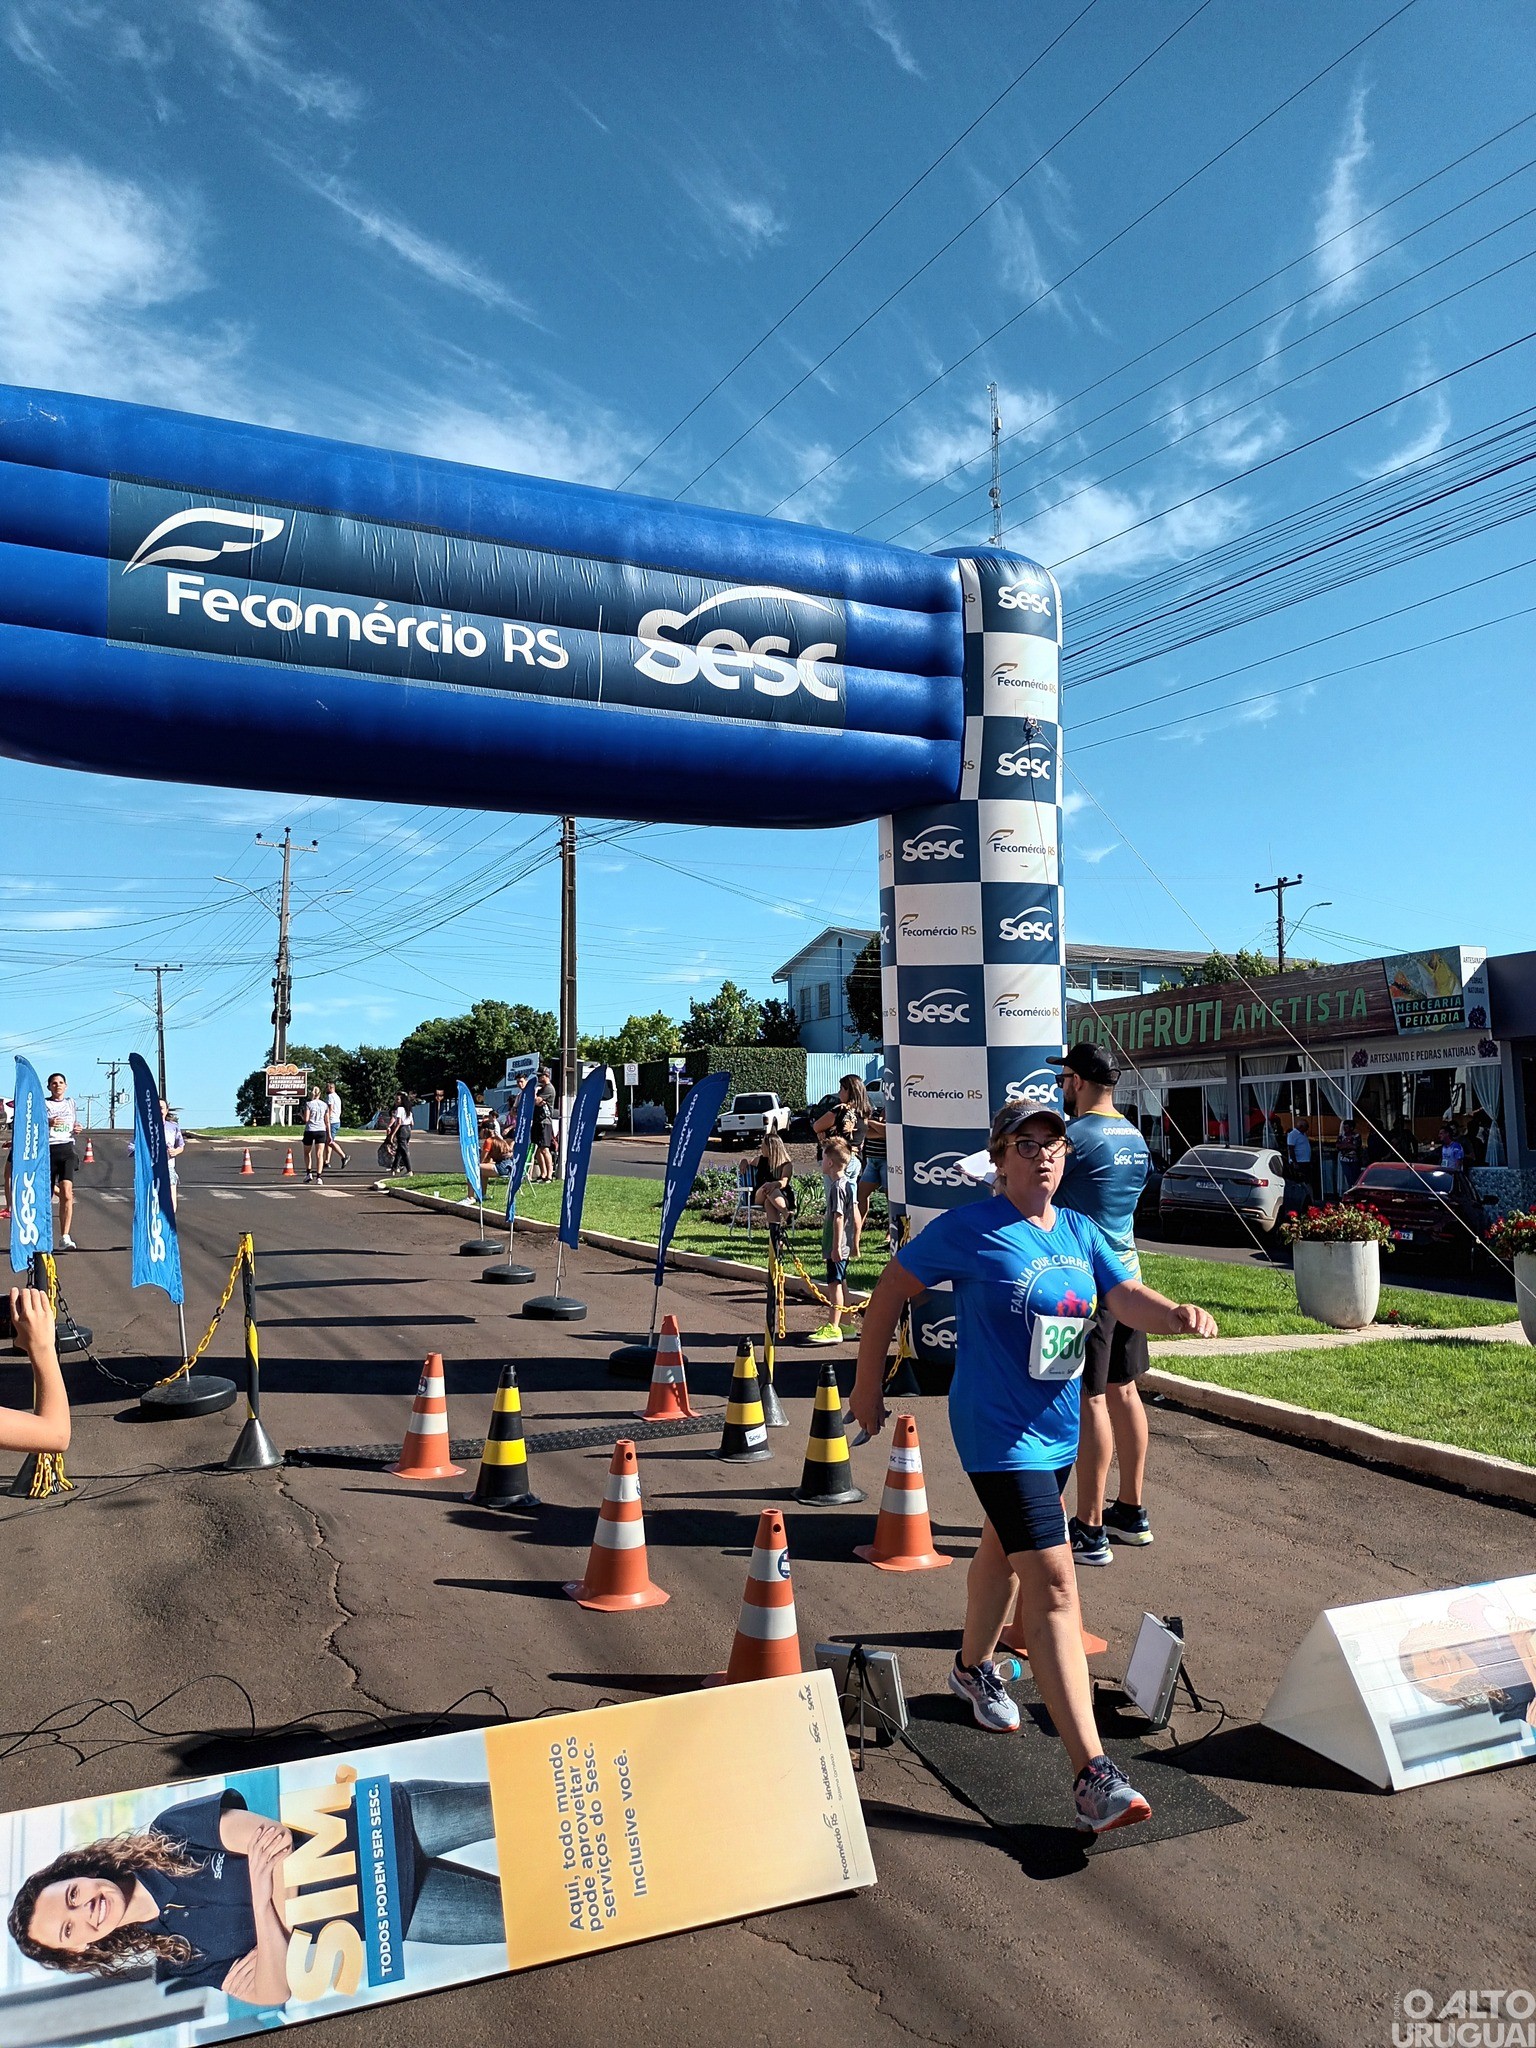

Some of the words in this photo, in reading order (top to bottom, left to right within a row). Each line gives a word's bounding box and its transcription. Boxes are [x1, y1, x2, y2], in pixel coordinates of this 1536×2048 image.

[997, 578, 1052, 617] Sesc
[166, 571, 487, 659] Fecomércio
[503, 622, 570, 671] RS
[634, 585, 840, 702] Sesc
[997, 676, 1048, 692] Fecomércio
[1049, 680, 1057, 694] RS
[996, 742, 1052, 780] Sesc
[902, 824, 965, 862] Sesc
[993, 842, 1046, 855] Fecomércio
[1047, 845, 1056, 856] RS
[902, 924, 958, 937] Fecomércio
[961, 925, 977, 936] RS
[998, 906, 1054, 941] Sesc
[907, 988, 970, 1023] Sesc
[999, 1006, 1051, 1018] Fecomércio
[1052, 1007, 1060, 1018] RS
[1067, 1000, 1222, 1051] HORTIFRUTI
[1232, 987, 1368, 1031] AMETISTA
[1396, 996, 1462, 1013] MERCEARIA
[1405, 1011, 1460, 1027] PEIXARIA
[1370, 1051, 1410, 1064] ARTESANATO
[1411, 1051, 1415, 1061] E
[1416, 1049, 1441, 1061] PEDRAS
[1443, 1046, 1476, 1059] NATURAIS
[908, 1088, 964, 1100] Fecomércio
[967, 1088, 983, 1100] RS
[1005, 1068, 1058, 1104] Sesc
[23, 1091, 33, 1161] Fecomércio
[673, 1093, 699, 1167] Fecomércio
[677, 1128, 693, 1167] Senac
[1114, 1147, 1132, 1165] Sesc
[12, 1172, 39, 1245] Sesc
[146, 1177, 166, 1263] Sesc
[1010, 1267, 1036, 1315] FAMÍLIA
[1031, 1256, 1052, 1271] QUE
[1051, 1254, 1090, 1272] CORRE
[921, 1315, 957, 1349] Se
[566, 1736, 578, 1759] os
[809, 1721, 821, 1744] Sesc
[549, 1743, 569, 1813] mundo
[583, 1742, 599, 1794] Sesc.
[613, 1749, 633, 1802] você.
[818, 1755, 834, 1801] Sindicatos
[368, 1783, 382, 1827] SESC.
[569, 1766, 594, 1869] aproveitar
[589, 1799, 604, 1826] do
[831, 1812, 838, 1826] RS
[370, 1827, 385, 1859] SER
[558, 1819, 576, 1870] todo
[624, 1807, 648, 1897] Inclusive
[834, 1827, 850, 1880] Fecomércio
[211, 1852, 226, 1880] Sesc
[595, 1832, 617, 1918] serviços
[373, 1860, 390, 1921] PODEM
[565, 1874, 585, 1930] Aqui,
[582, 1876, 604, 1932] pode
[375, 1921, 393, 1978] TODOS
